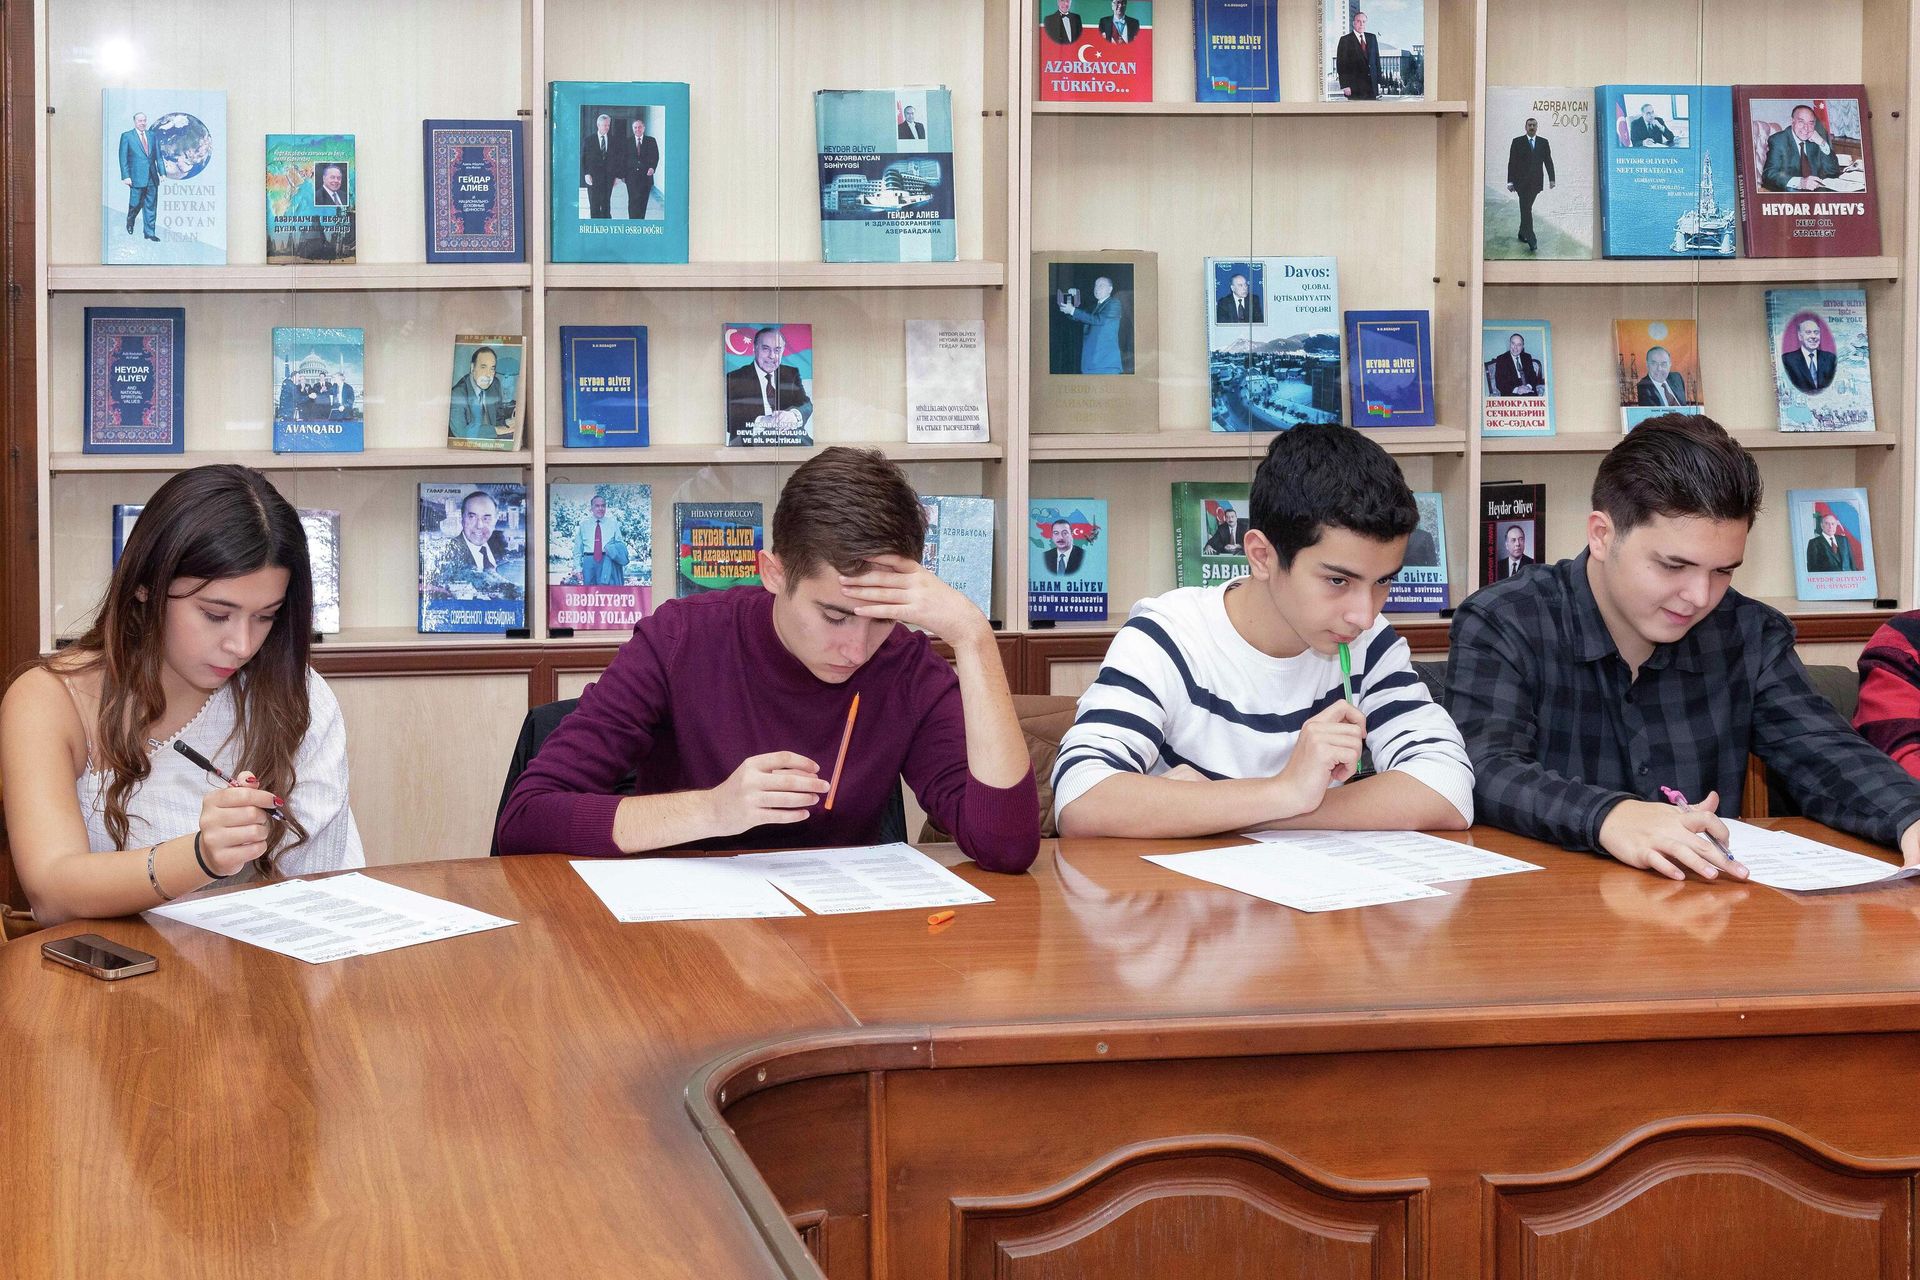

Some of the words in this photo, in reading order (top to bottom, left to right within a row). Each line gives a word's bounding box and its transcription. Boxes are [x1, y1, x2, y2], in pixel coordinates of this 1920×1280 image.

[1044, 61, 1136, 75] AZƏRBAYCAN
[1051, 76, 1130, 93] TÜRKİYƏ...
[1533, 101, 1588, 111] AZƏRBAYCAN
[1552, 111, 1588, 134] 2003
[824, 145, 850, 153] HEYDƏR
[852, 144, 876, 153] ƏLİYEV
[458, 175, 491, 184] ГЕЙДАР
[163, 183, 216, 196] DÜNYANI
[164, 201, 215, 211] HEYRAN
[1762, 203, 1810, 216] HEYDAR
[1814, 203, 1865, 216] ALIYEV'S
[887, 210, 914, 220] ГЕЙДАР
[916, 211, 940, 219] АЛИЕВ
[579, 223, 609, 234] BİRLİKDƏ
[610, 224, 624, 234] YENİ
[642, 224, 664, 235] DOĞRU
[1793, 230, 1836, 238] STRATEGY
[1285, 265, 1330, 278] Davos:
[114, 366, 150, 374] HEYDAR
[285, 424, 343, 434] AVANQARD
[691, 510, 723, 518] HİDAYƏT
[724, 510, 754, 518] ORUCOV
[1488, 500, 1512, 519] Heydər
[1513, 499, 1533, 518] Əliyev
[692, 528, 724, 546] HEYDƏR
[943, 528, 987, 538] AZƏRBAYCAN
[692, 550, 702, 561] VƏ
[703, 550, 756, 561] AZƏRBAYCANDA
[942, 554, 965, 563] ZAMAN
[1066, 579, 1103, 592] ƏLİYEV
[565, 590, 636, 607] ƏBƏDİYYƏTƏ
[558, 611, 595, 624] GEDƏN
